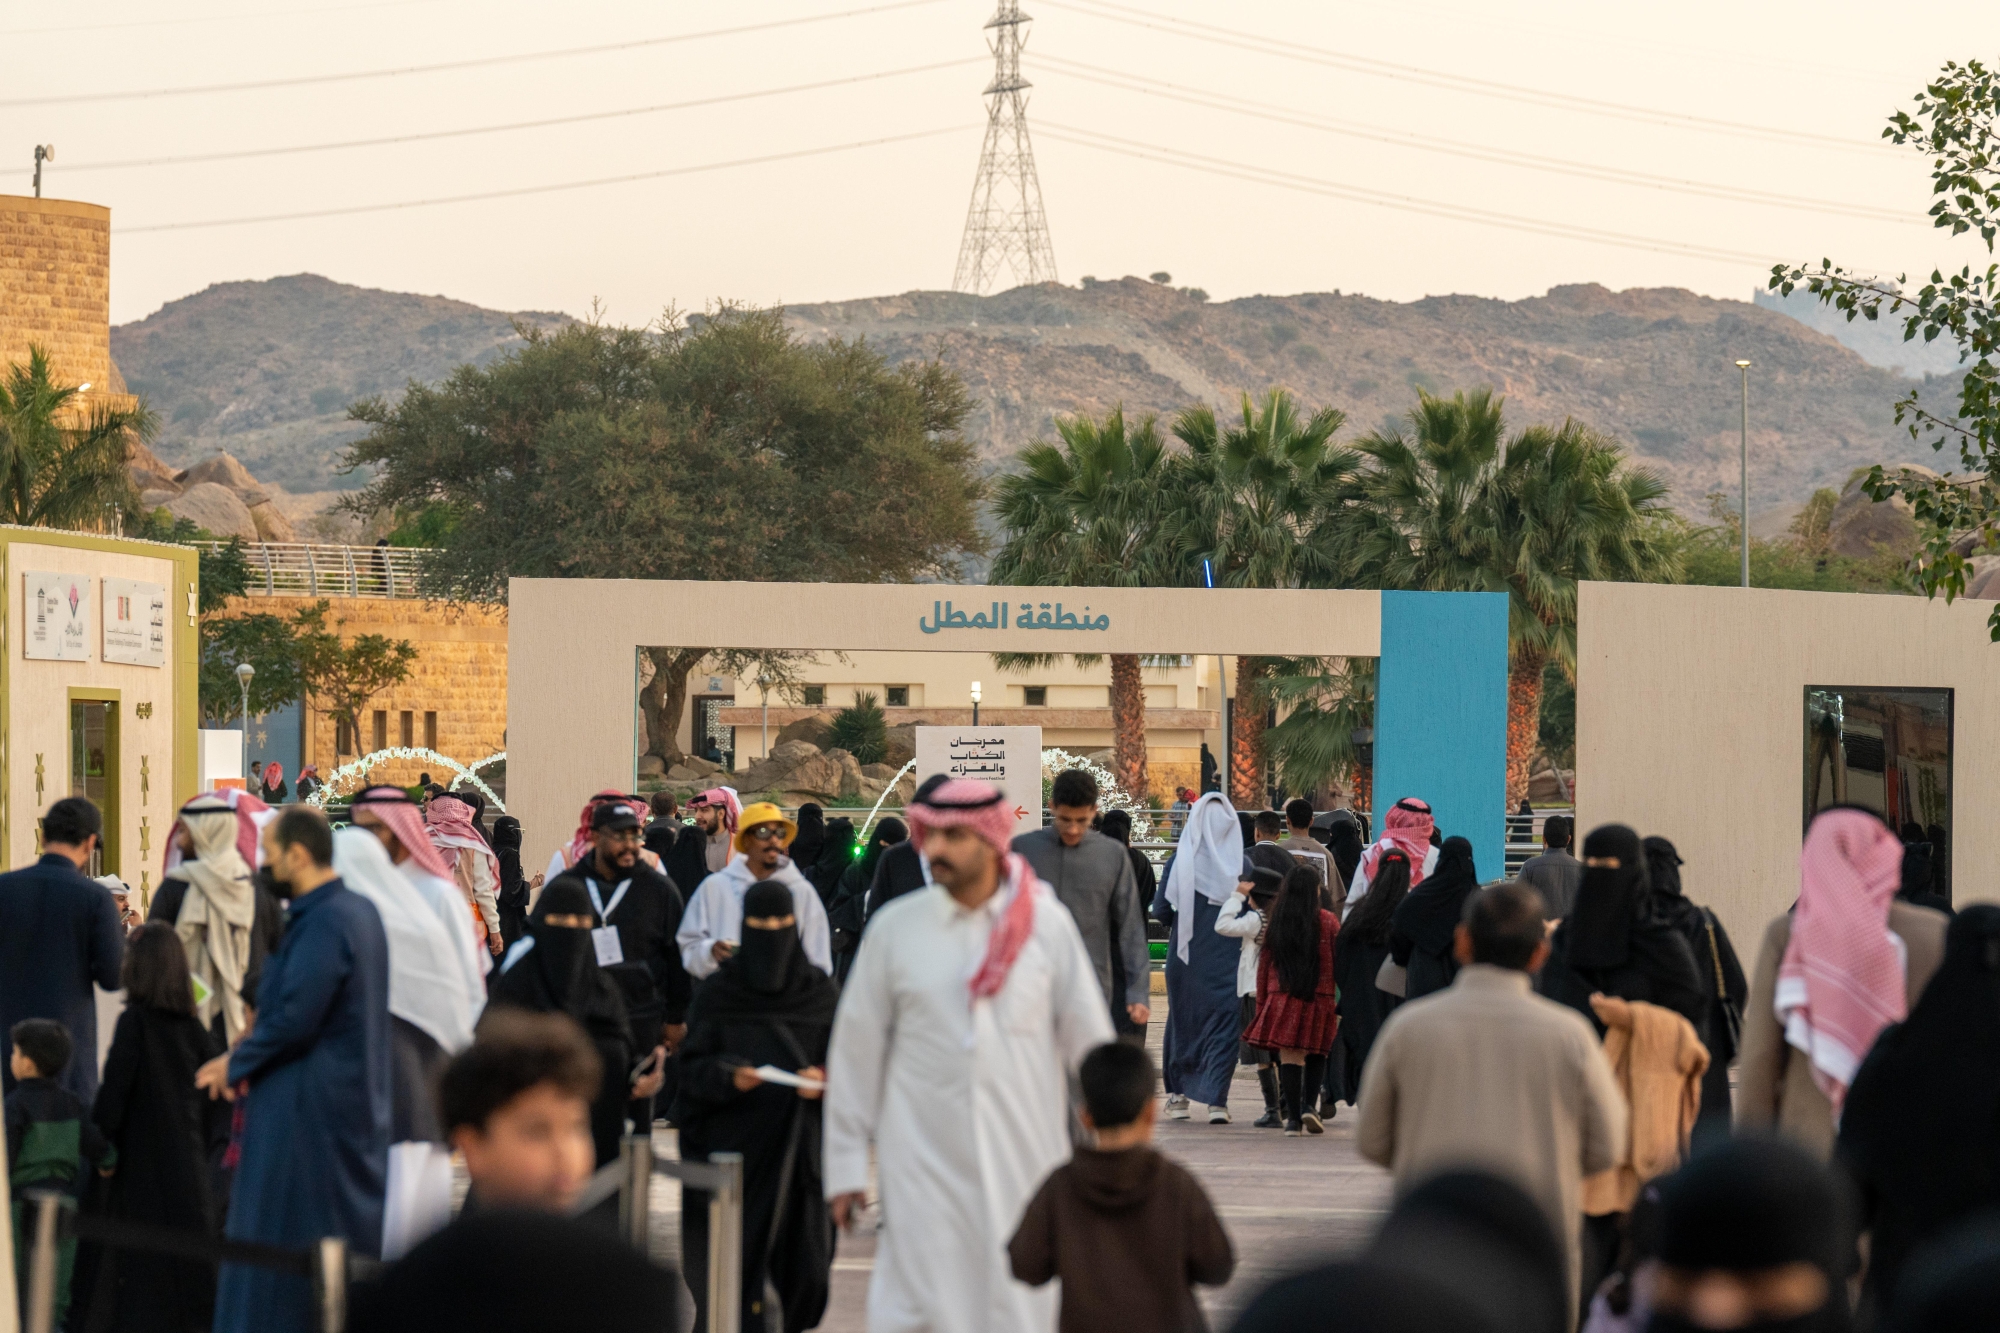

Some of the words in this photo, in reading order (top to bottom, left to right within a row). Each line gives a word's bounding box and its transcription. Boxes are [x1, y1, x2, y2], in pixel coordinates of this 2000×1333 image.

[920, 601, 1008, 634] المطل
[1016, 602, 1110, 631] منطقة
[950, 736, 1005, 749] مهرجان
